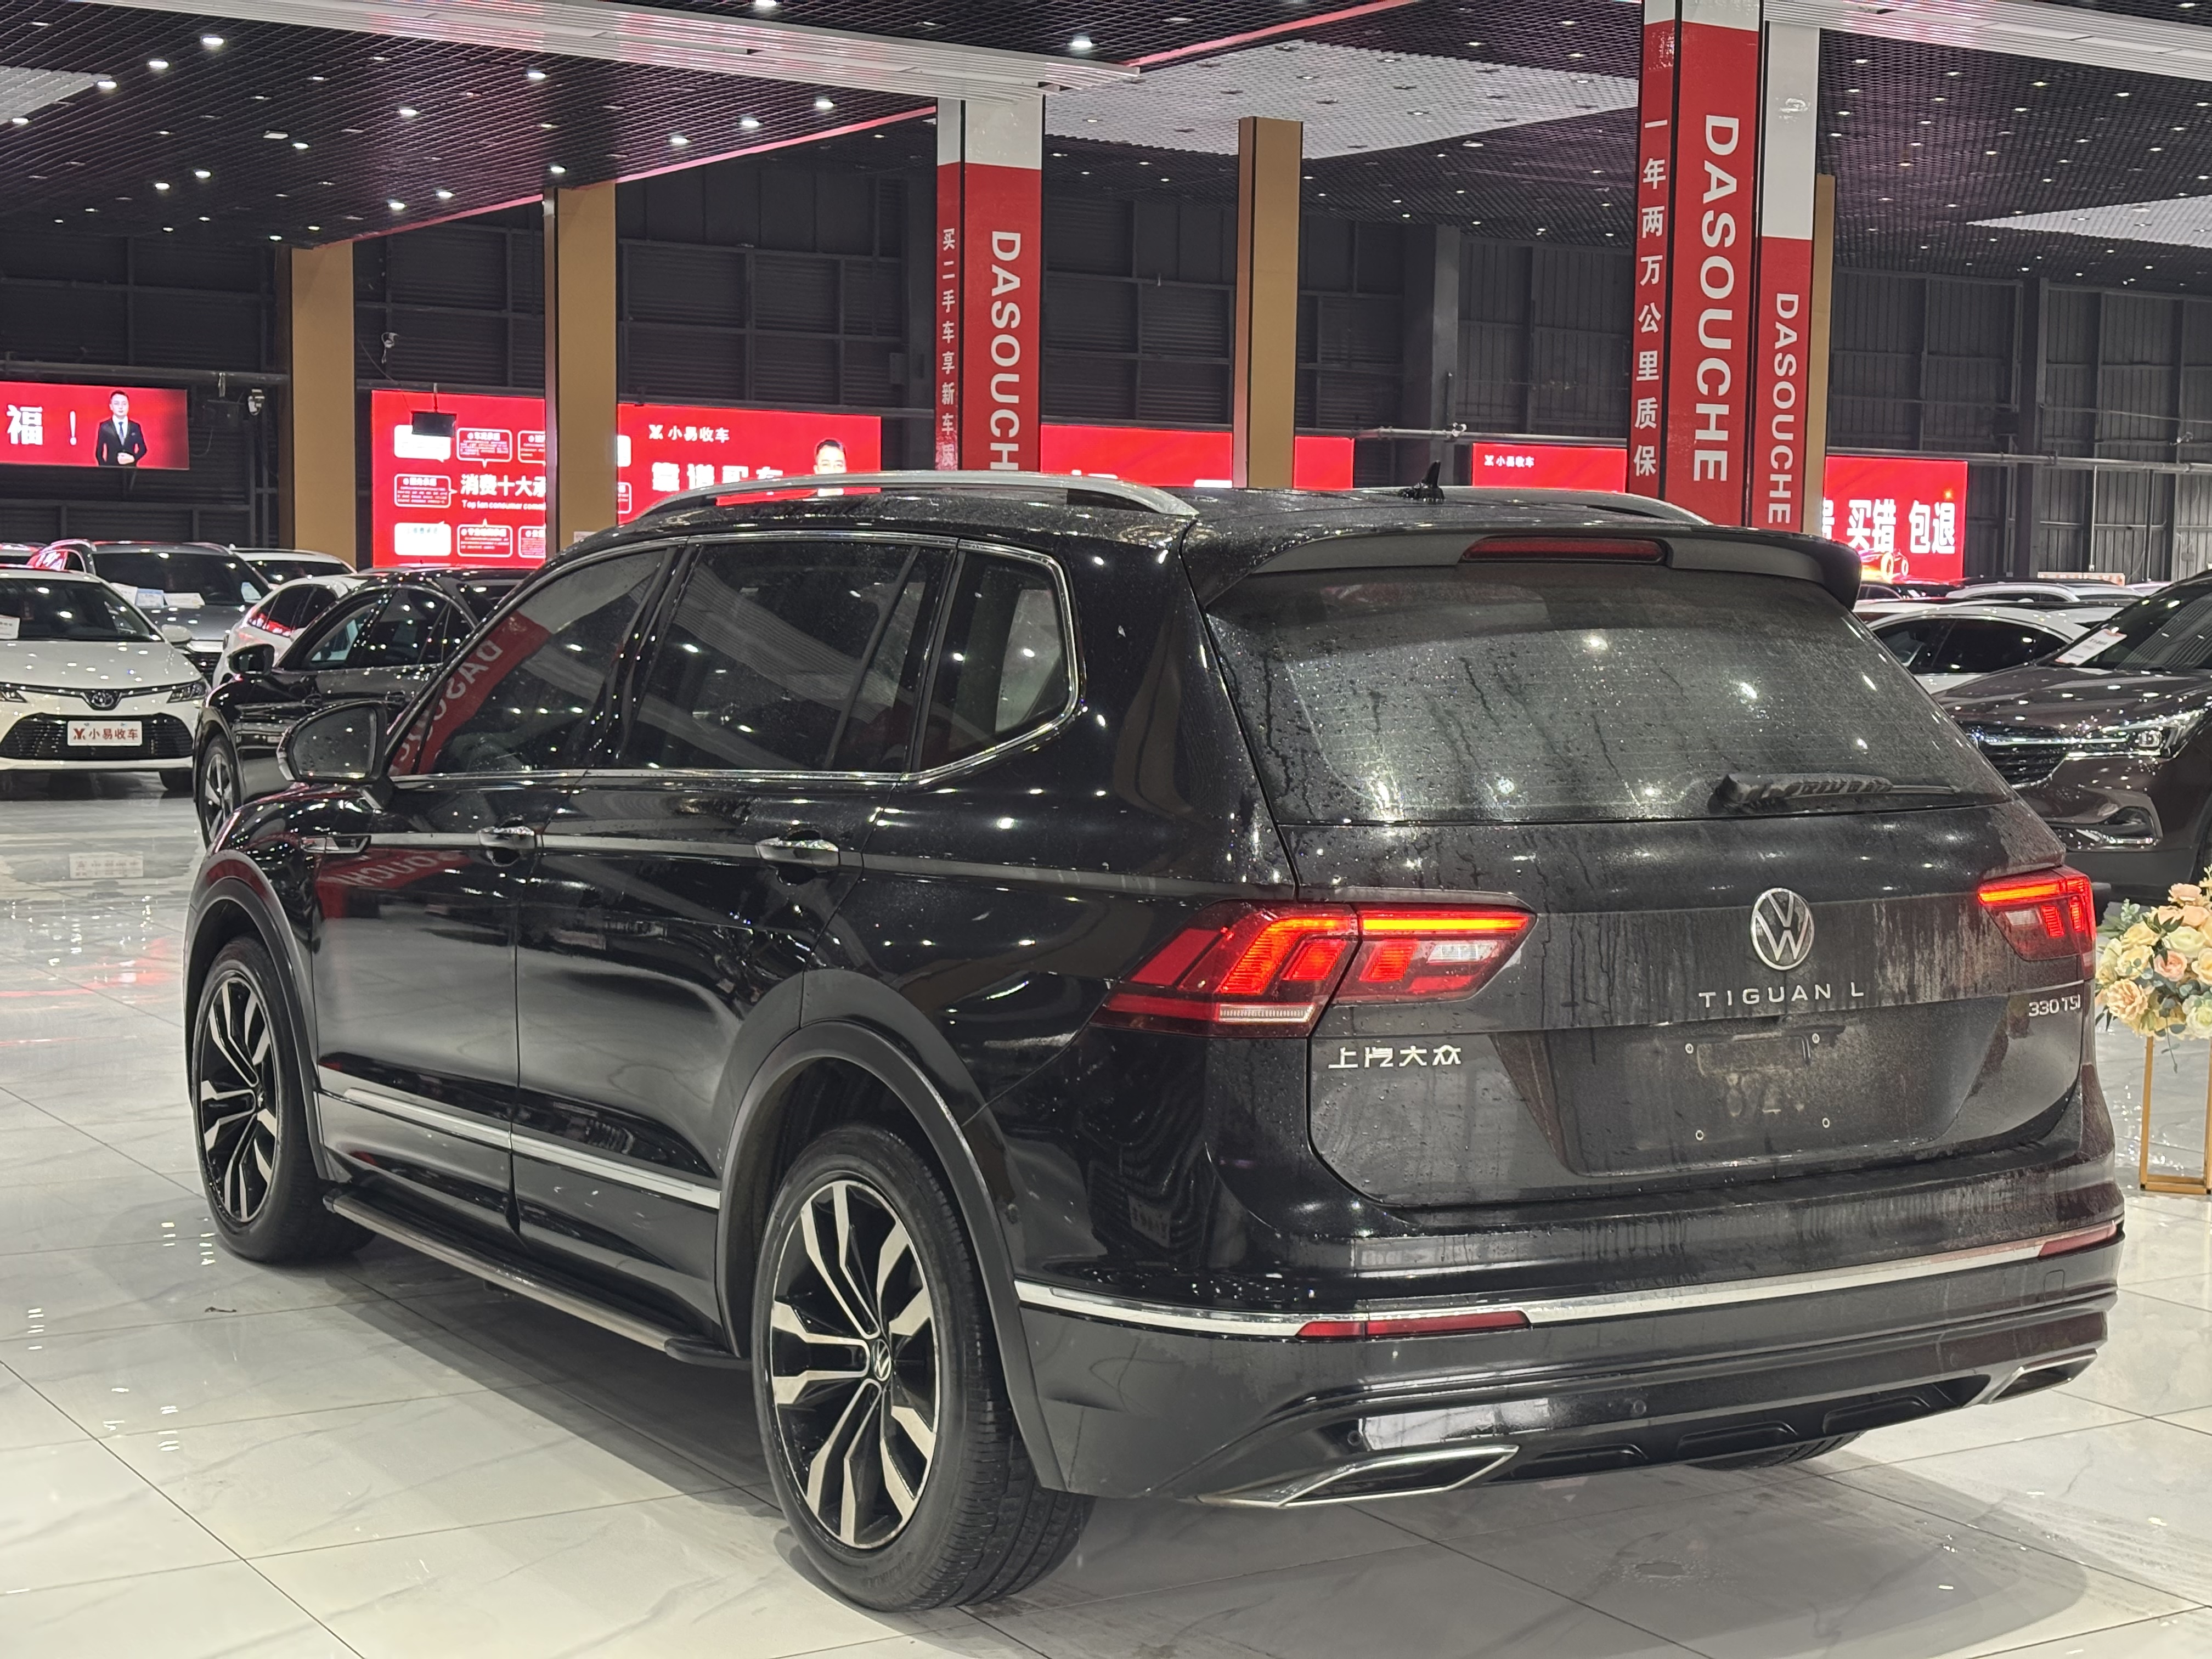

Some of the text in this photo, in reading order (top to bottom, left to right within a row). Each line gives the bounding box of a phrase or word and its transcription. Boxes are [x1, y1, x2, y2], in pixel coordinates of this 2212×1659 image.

[1633, 119, 1668, 477] 一年两万公里质保
[1693, 114, 1739, 482] DASOUCHE
[989, 230, 1022, 471] DASOUCH
[1768, 292, 1799, 524] DASOUCHE
[668, 425, 730, 443] 小易收车
[88, 728, 138, 740] 小易收车
[1699, 981, 1864, 1008] TIGUAN L
[2029, 998, 2060, 1017] 330
[1328, 1045, 1462, 1069] 上汽大众
